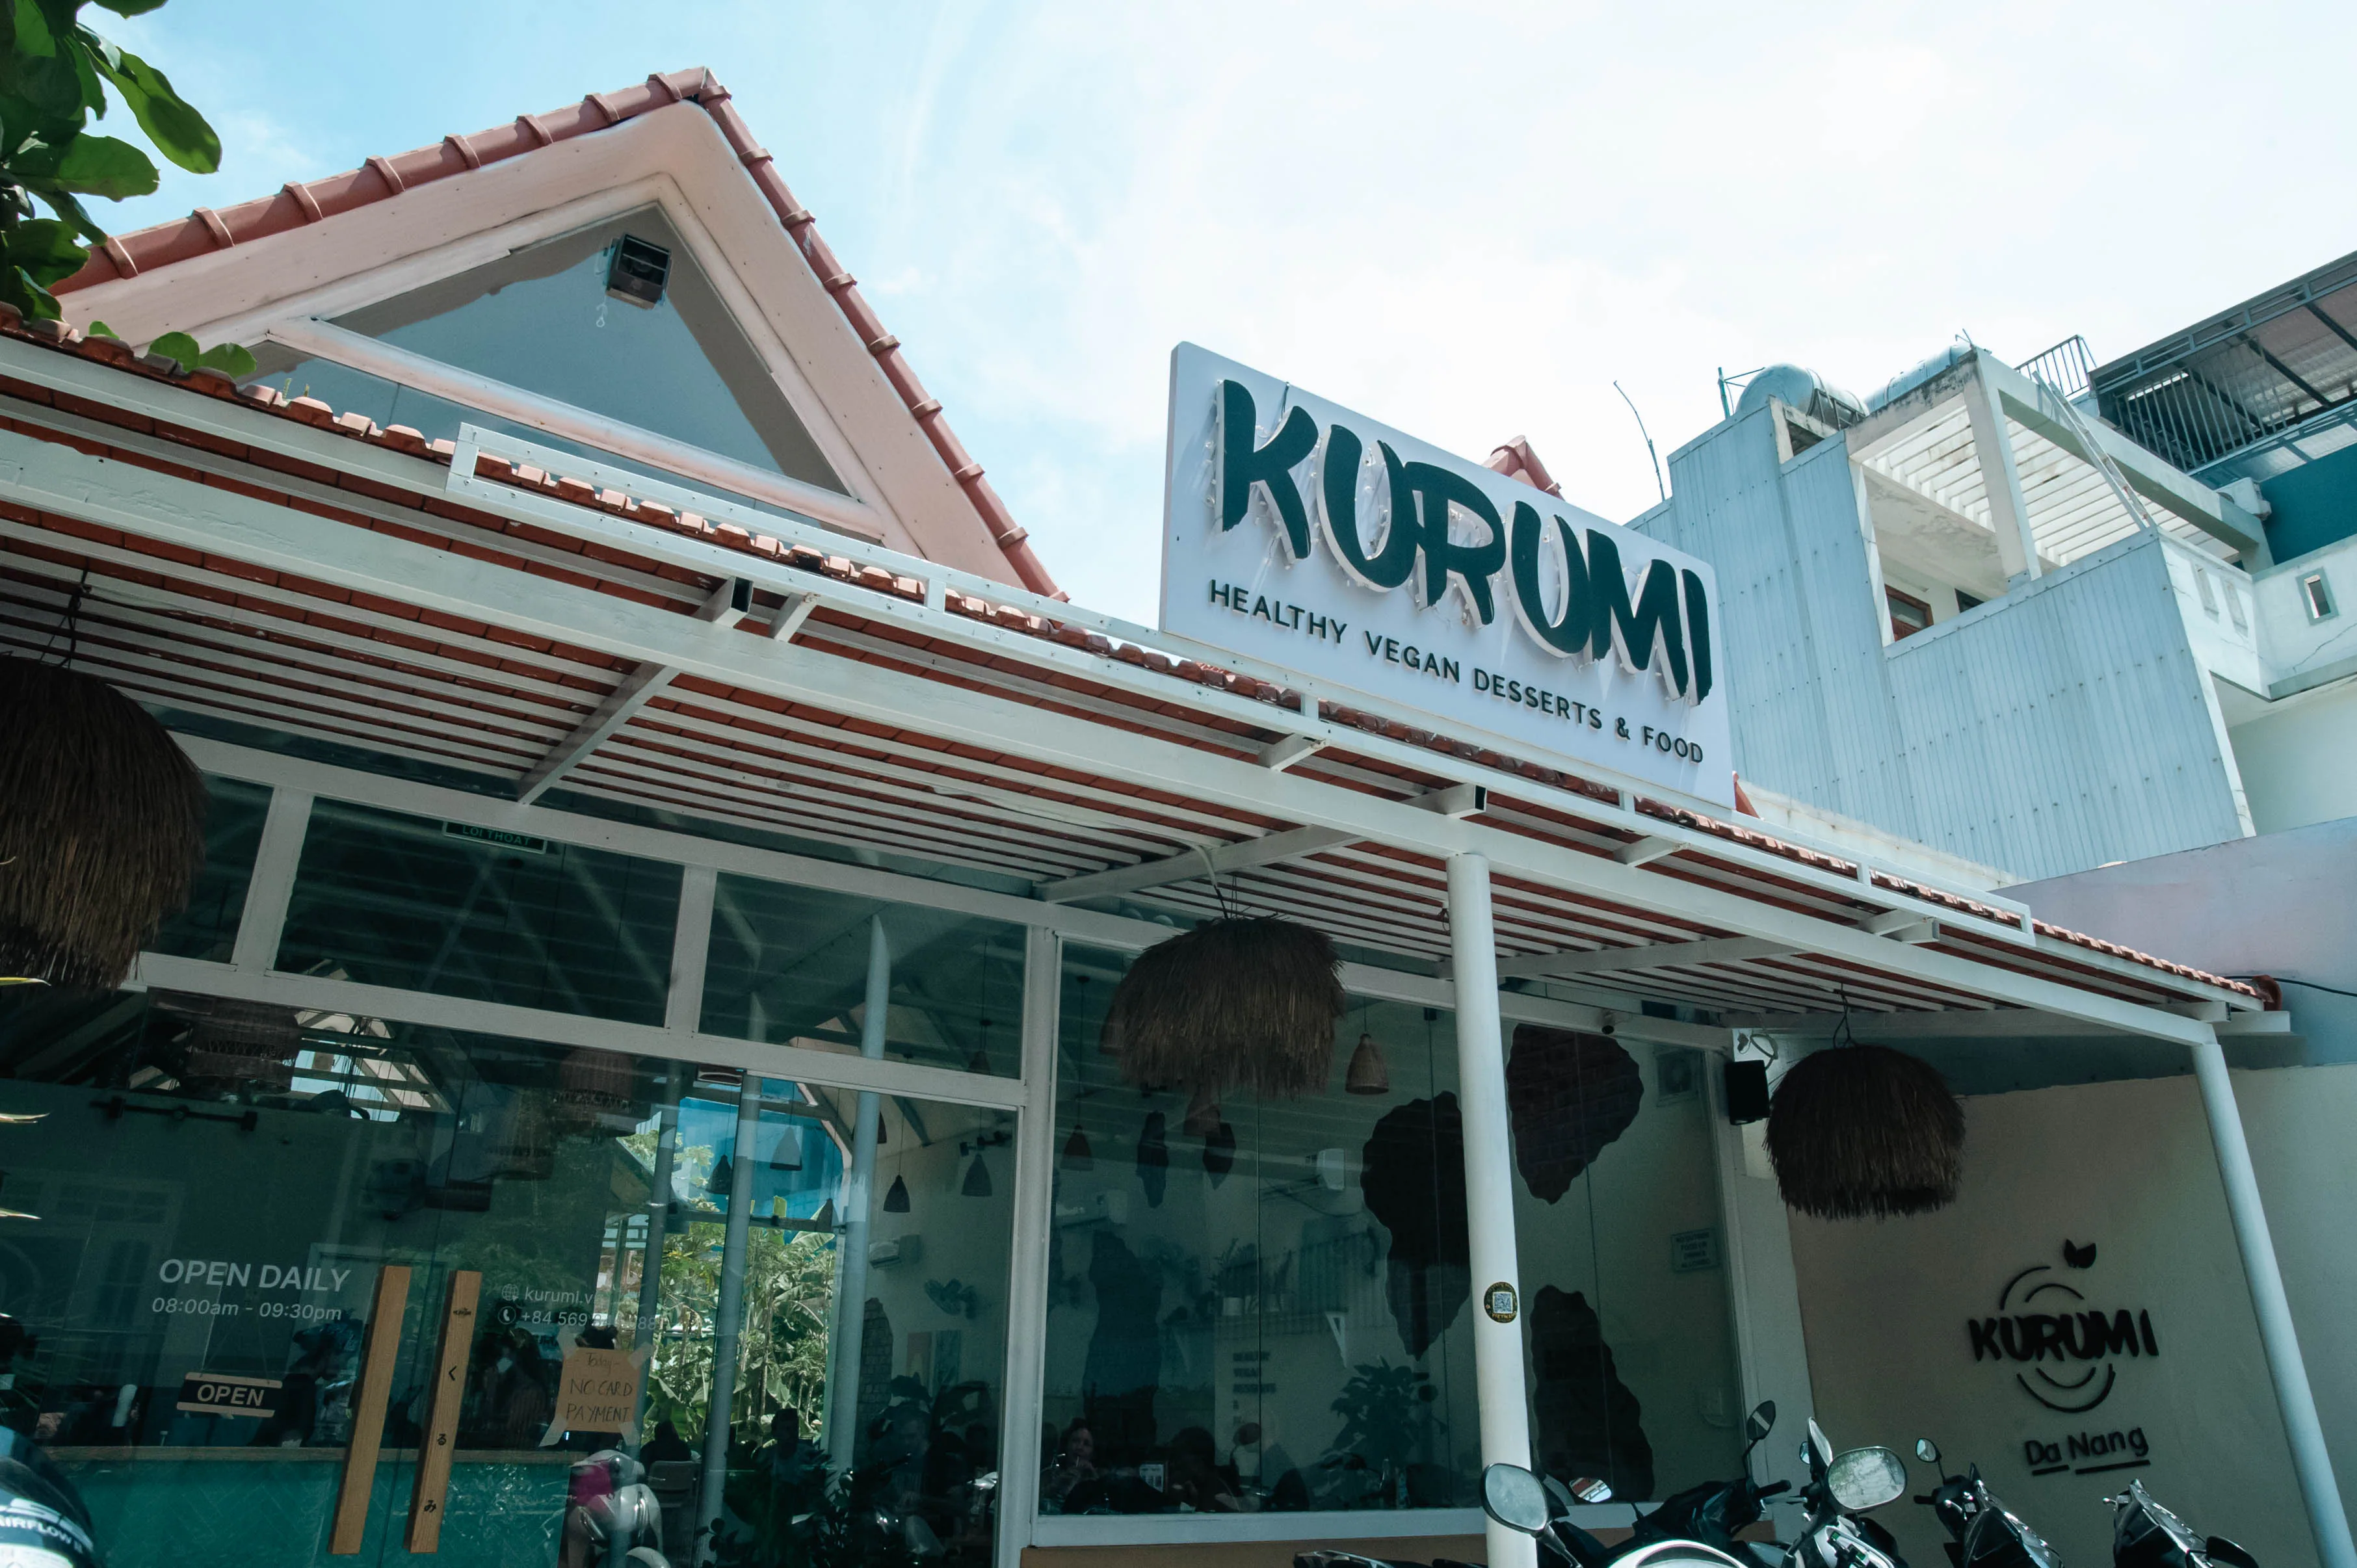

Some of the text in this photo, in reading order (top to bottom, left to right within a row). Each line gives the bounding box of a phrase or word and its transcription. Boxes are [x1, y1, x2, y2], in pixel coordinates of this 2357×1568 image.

[1216, 380, 1713, 706] KURUMI
[1210, 579, 1704, 764] HEALTHY VEGAN DESSERTS & FOOD
[159, 1259, 352, 1292] OPEN DAILY
[152, 1298, 239, 1316] 08:00am
[259, 1302, 341, 1322] 09:30pm
[521, 1311, 552, 1324] +84
[558, 1312, 588, 1326] 569
[1968, 1309, 2159, 1361] KURUMI
[197, 1384, 265, 1407] OPEN
[570, 1378, 633, 1397] NO CARD
[566, 1403, 630, 1423] PAYMENT
[2024, 1427, 2150, 1466] Da Nang
